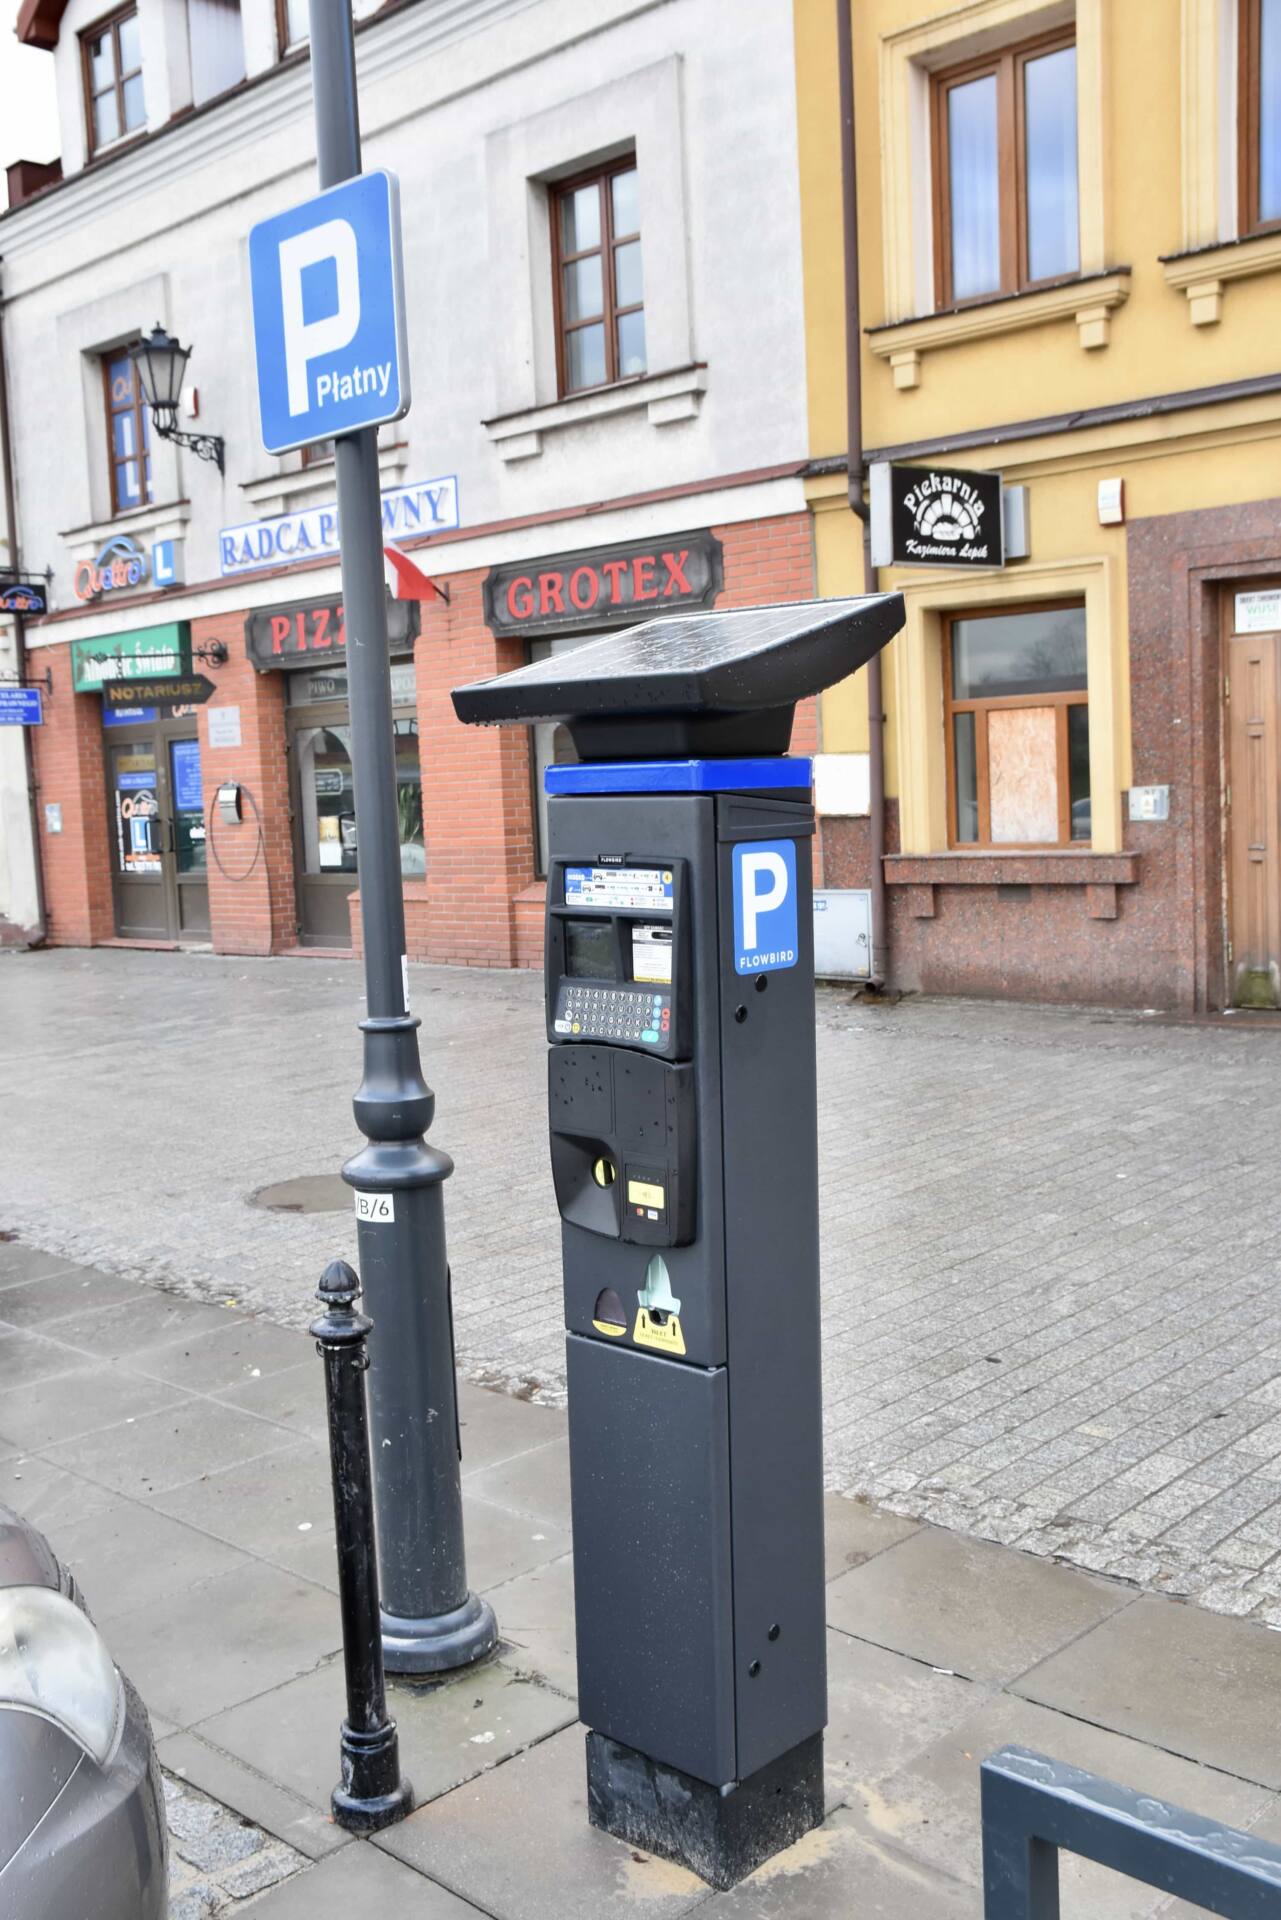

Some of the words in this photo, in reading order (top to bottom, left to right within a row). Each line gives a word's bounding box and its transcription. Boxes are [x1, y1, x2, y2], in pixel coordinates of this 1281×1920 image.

[278, 218, 361, 417] P
[316, 361, 392, 408] Płatny
[903, 473, 986, 517] Piekarnia
[221, 519, 313, 566] RADCA
[318, 486, 446, 545] PWNY
[156, 546, 173, 580] L
[905, 539, 958, 559] Kazimiera
[74, 556, 142, 601] Quattro
[506, 549, 693, 620] GROTEX
[109, 683, 202, 701] NOTARIUSZ
[741, 851, 789, 951] P
[739, 950, 794, 969] FLOWBIRD
